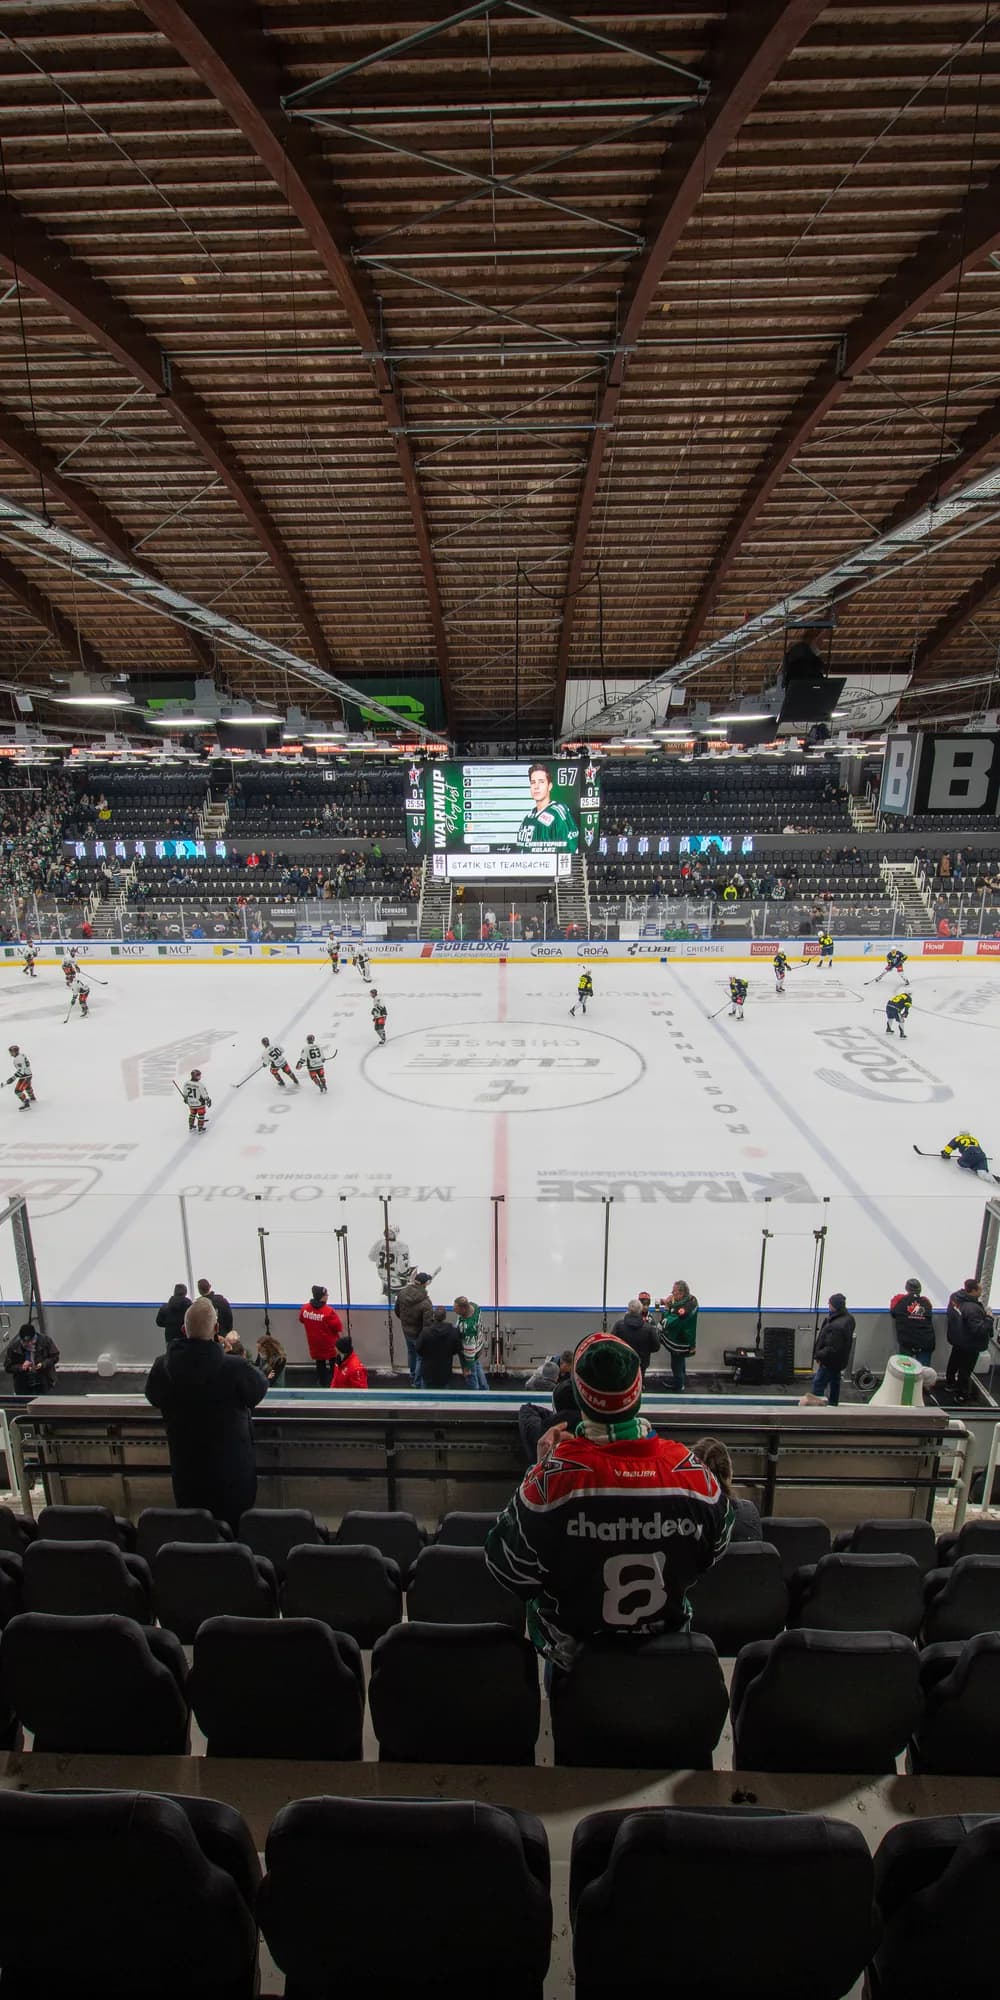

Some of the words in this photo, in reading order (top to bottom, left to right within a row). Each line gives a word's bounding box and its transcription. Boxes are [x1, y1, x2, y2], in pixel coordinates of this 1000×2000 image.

[557, 767, 578, 786] 67
[927, 739, 995, 809] B
[432, 769, 446, 848] WARMUP
[483, 861, 497, 870] IST
[499, 860, 551, 870] TEAMSACHE
[16, 946, 41, 955] MP
[121, 945, 145, 955] MCP
[169, 945, 192, 954] MCP
[583, 947, 609, 955] ROFA
[752, 944, 777, 952] komro
[424, 1038, 581, 1048] CHIEMSEE
[268, 1047, 282, 1061] 50
[309, 1047, 322, 1060] 63
[403, 1057, 600, 1068] CUBE
[187, 1087, 198, 1099] 21
[537, 1172, 820, 1204] KRAUSE
[302, 1310, 325, 1322] Ordner
[622, 1470, 657, 1479] BAUER
